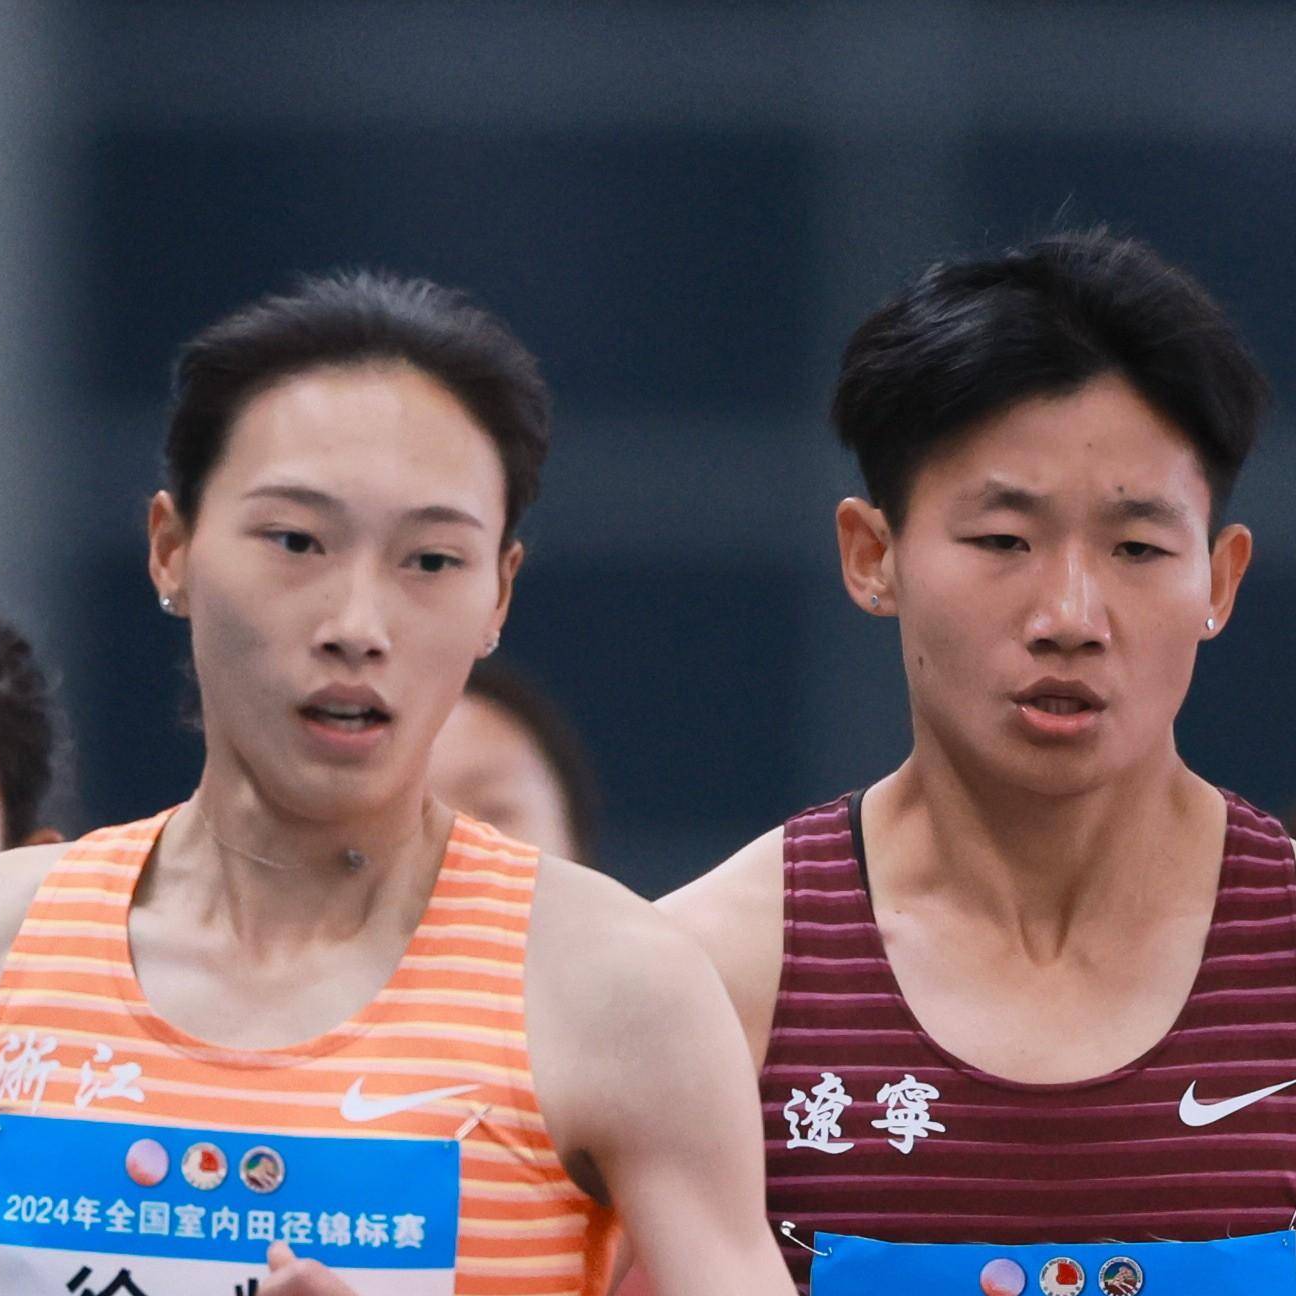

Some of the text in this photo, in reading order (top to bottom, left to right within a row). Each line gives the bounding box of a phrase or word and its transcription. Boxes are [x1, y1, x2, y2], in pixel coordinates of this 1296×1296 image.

[3, 1194, 427, 1250] 2024年全国室内田径锦标赛
